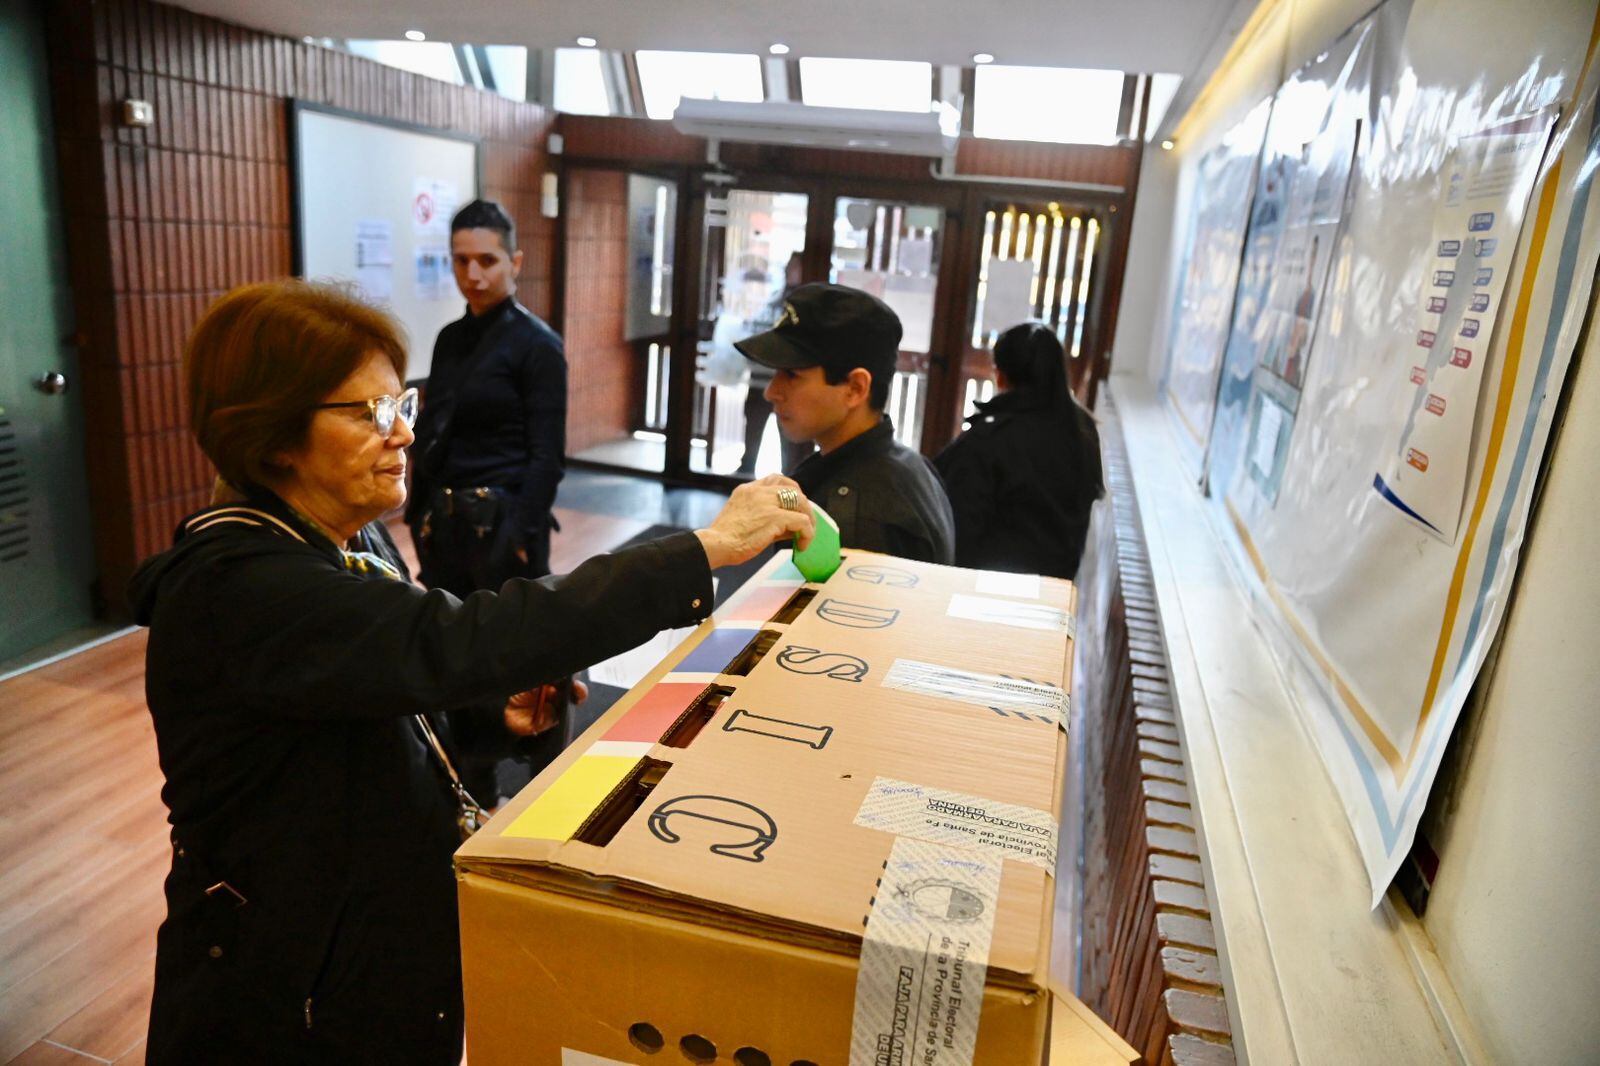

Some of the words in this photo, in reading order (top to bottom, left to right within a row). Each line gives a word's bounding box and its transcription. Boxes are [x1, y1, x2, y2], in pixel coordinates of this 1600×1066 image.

[846, 564, 919, 589] G
[816, 598, 900, 629] D
[776, 645, 869, 683] S
[722, 709, 834, 750] I
[926, 819, 939, 828] Fe
[927, 804, 984, 821] ARMADO
[982, 814, 1019, 829] PARA
[647, 794, 778, 863] C
[943, 823, 977, 835] Santa
[980, 830, 995, 838] de
[979, 838, 1033, 855] Electoral
[941, 937, 952, 949] de
[951, 940, 970, 994] Tribunal
[896, 966, 914, 1002] FAJA
[929, 969, 948, 1029] Provincia
[893, 1003, 908, 1038] PARA
[944, 996, 961, 1049] Electoral
[877, 1033, 892, 1052] DE
[927, 1031, 938, 1045] de
